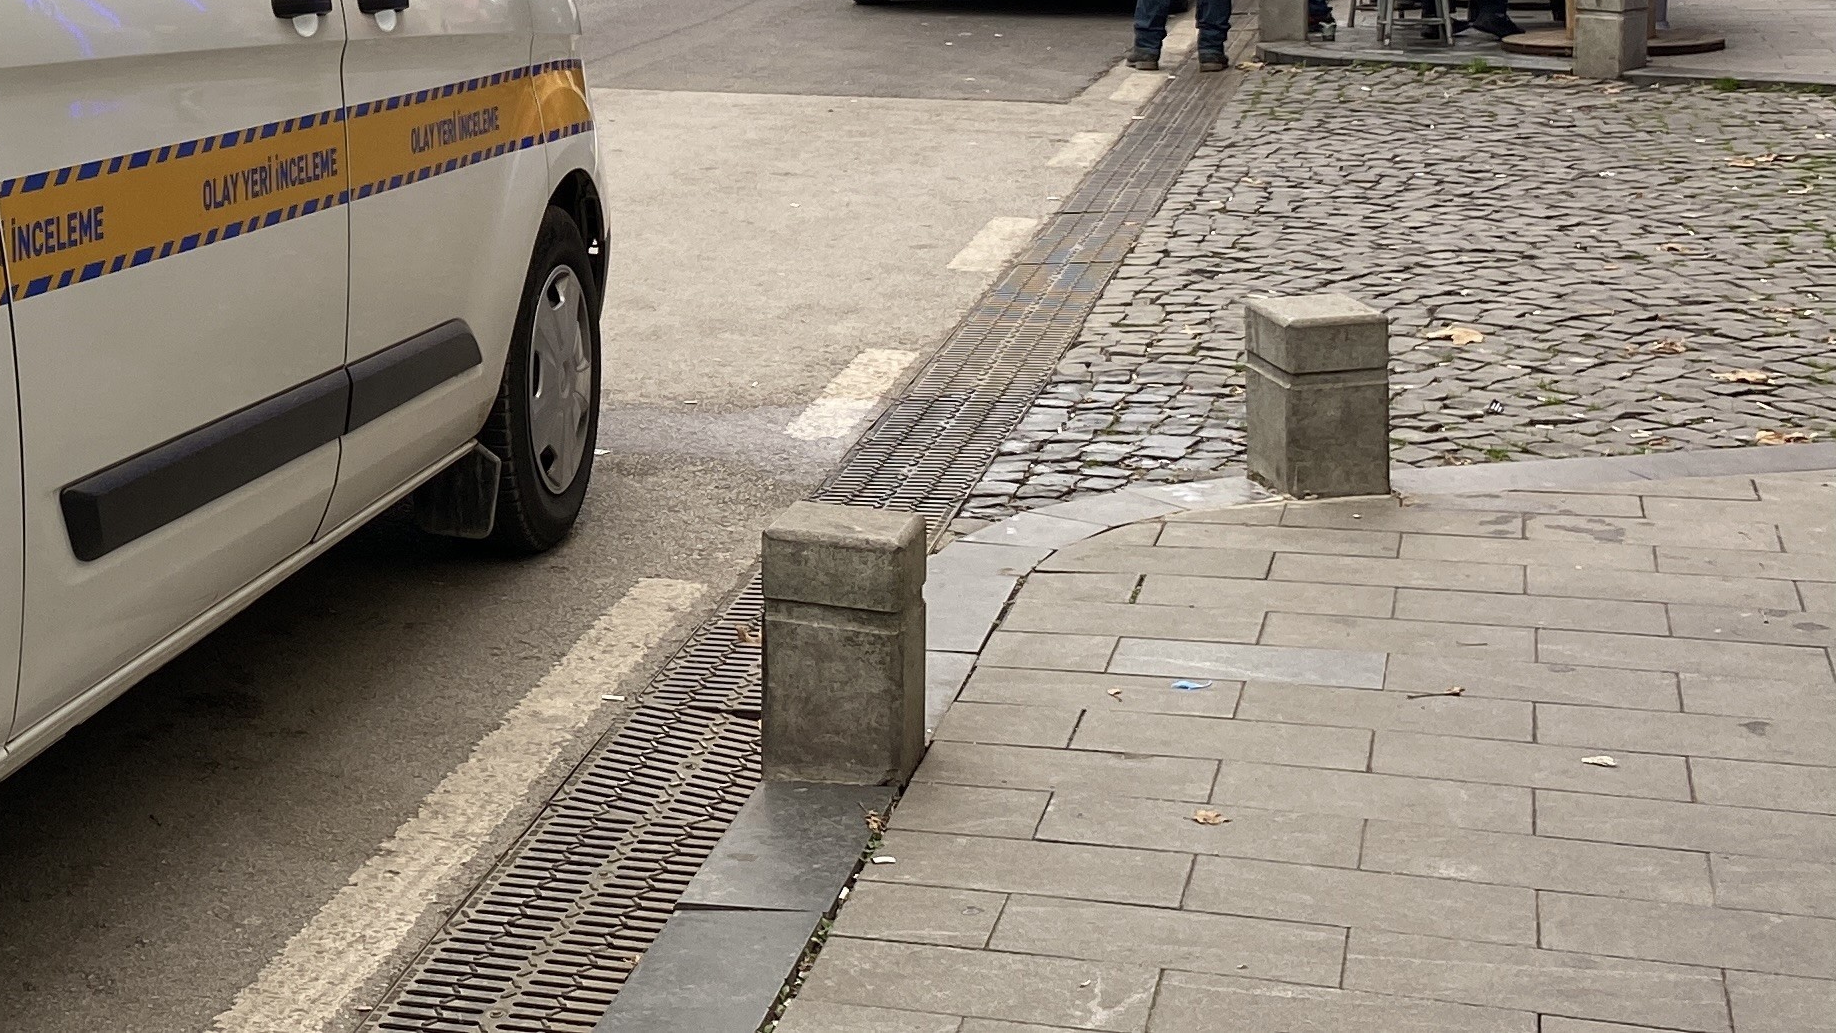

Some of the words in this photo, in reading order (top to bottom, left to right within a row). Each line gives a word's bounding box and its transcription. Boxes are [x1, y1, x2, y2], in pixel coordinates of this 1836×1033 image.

[411, 124, 435, 154] OLAY
[436, 111, 457, 148] YERİ
[457, 106, 500, 142] İNCELEME
[202, 171, 239, 211] OLAY
[241, 155, 271, 200] YERİ
[274, 148, 339, 193] İNCELEME
[11, 206, 104, 262] İNCELEME
